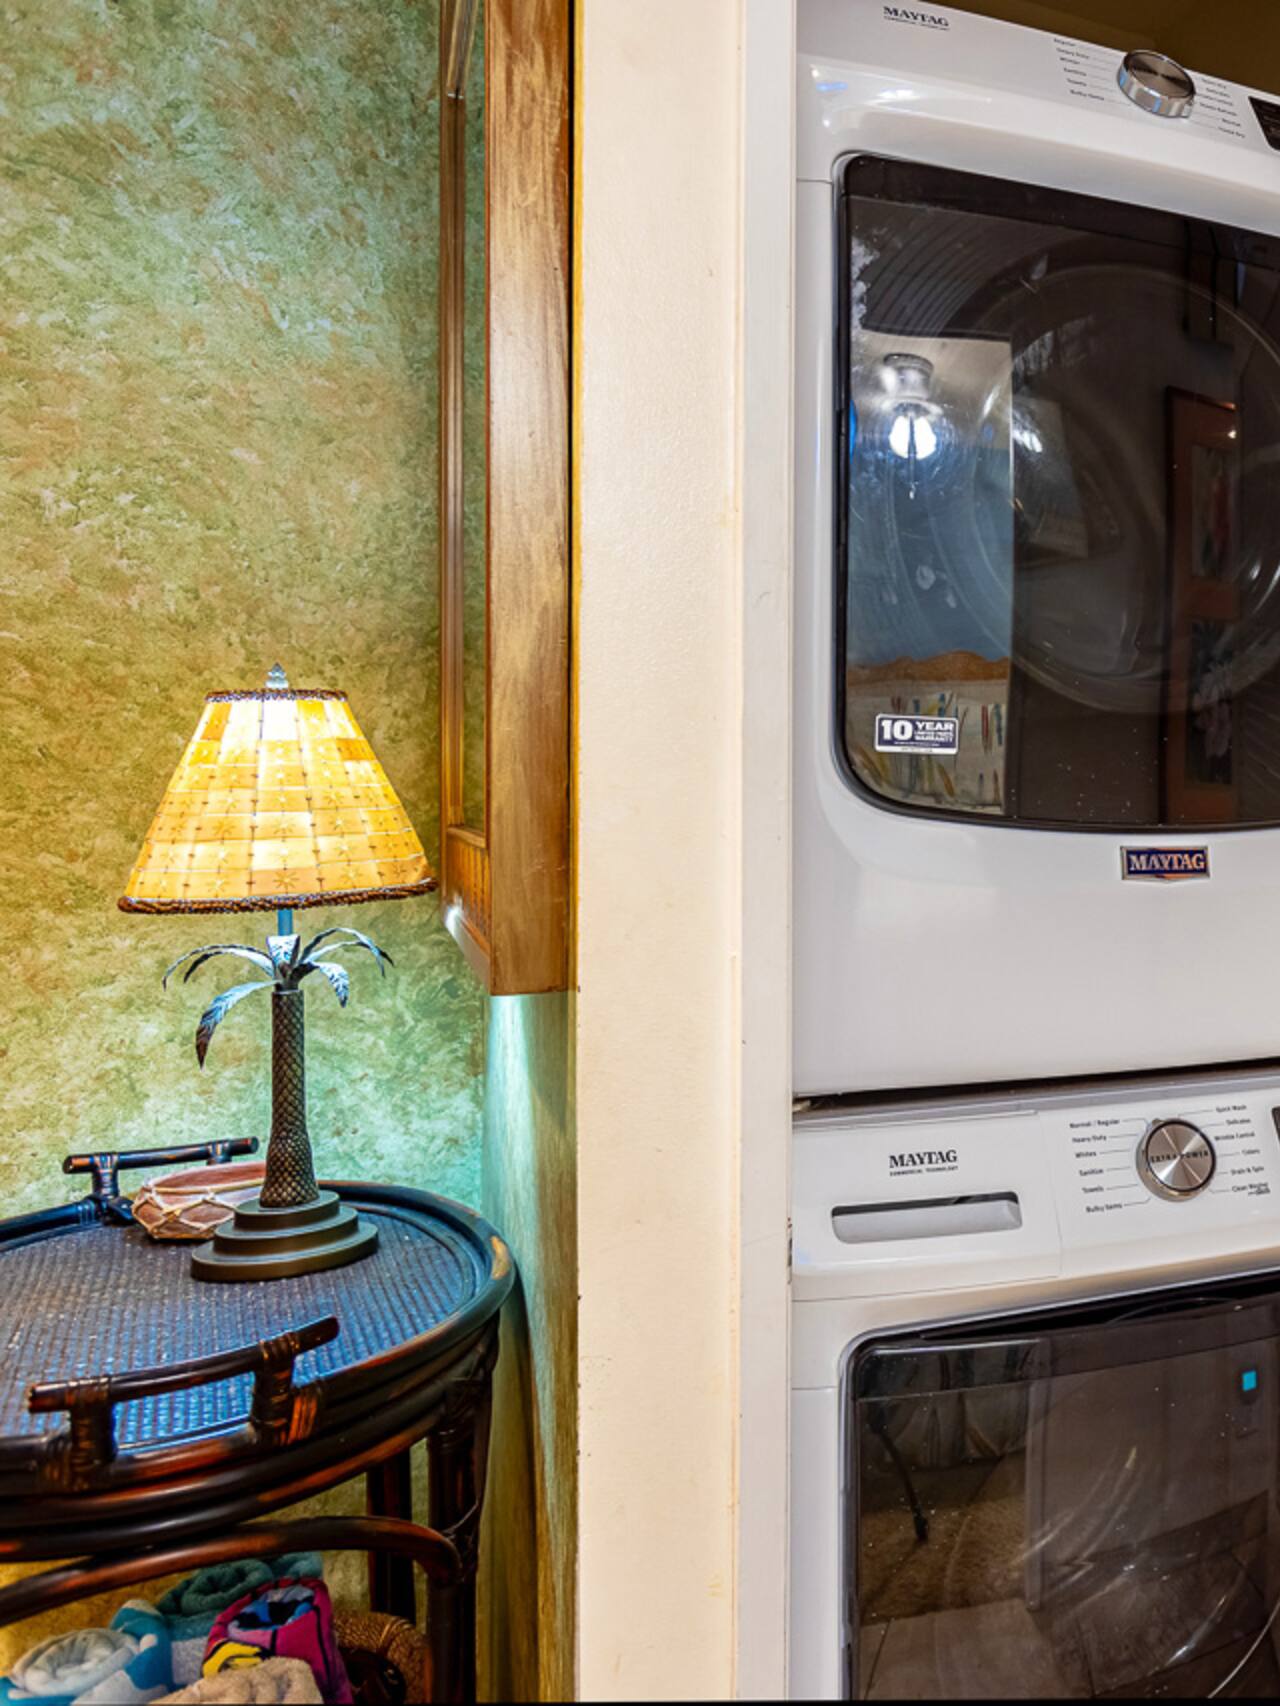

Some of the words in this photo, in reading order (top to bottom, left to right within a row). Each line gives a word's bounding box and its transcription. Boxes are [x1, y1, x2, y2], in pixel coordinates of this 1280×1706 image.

[883, 6, 949, 26] MAYTAG
[881, 719, 913, 741] 10
[915, 720, 954, 731] YEAR
[1129, 853, 1205, 870] MAYTAG
[889, 1149, 958, 1169] MAYTAG
[1150, 1154, 1177, 1163] EXTRA
